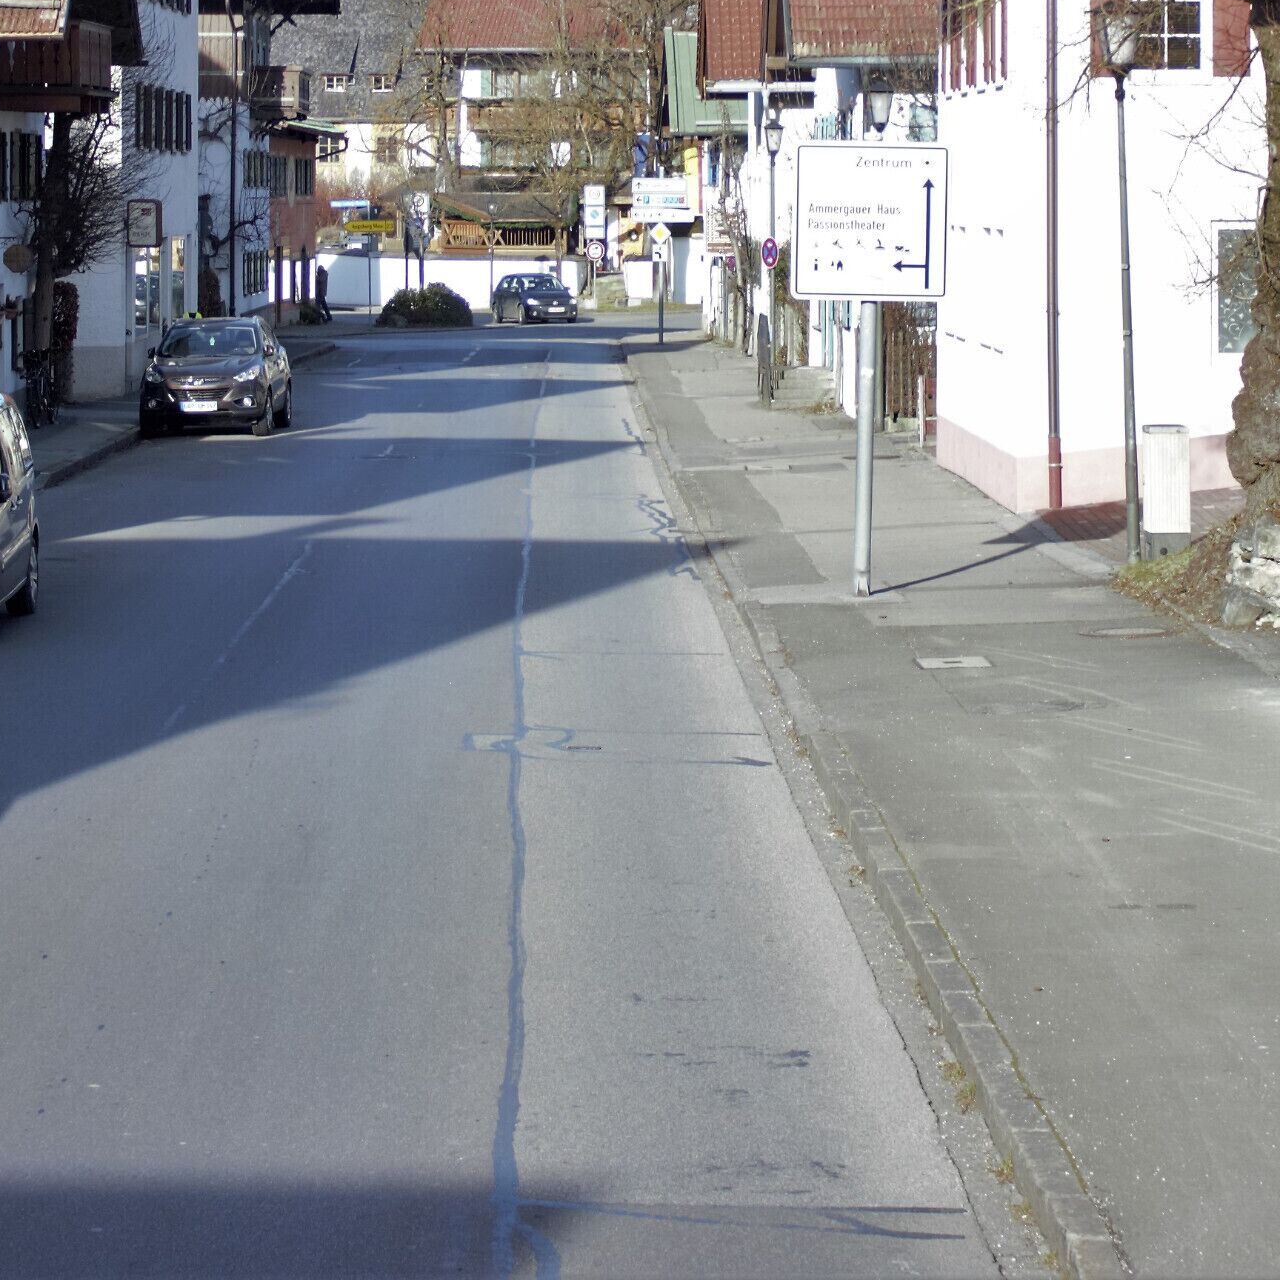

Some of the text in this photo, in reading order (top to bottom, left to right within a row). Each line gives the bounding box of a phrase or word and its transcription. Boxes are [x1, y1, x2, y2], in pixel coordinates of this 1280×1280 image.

[855, 155, 913, 169] Zentrum
[808, 203, 902, 217] Ammergauer Haus
[808, 218, 886, 231] Passionstheater
